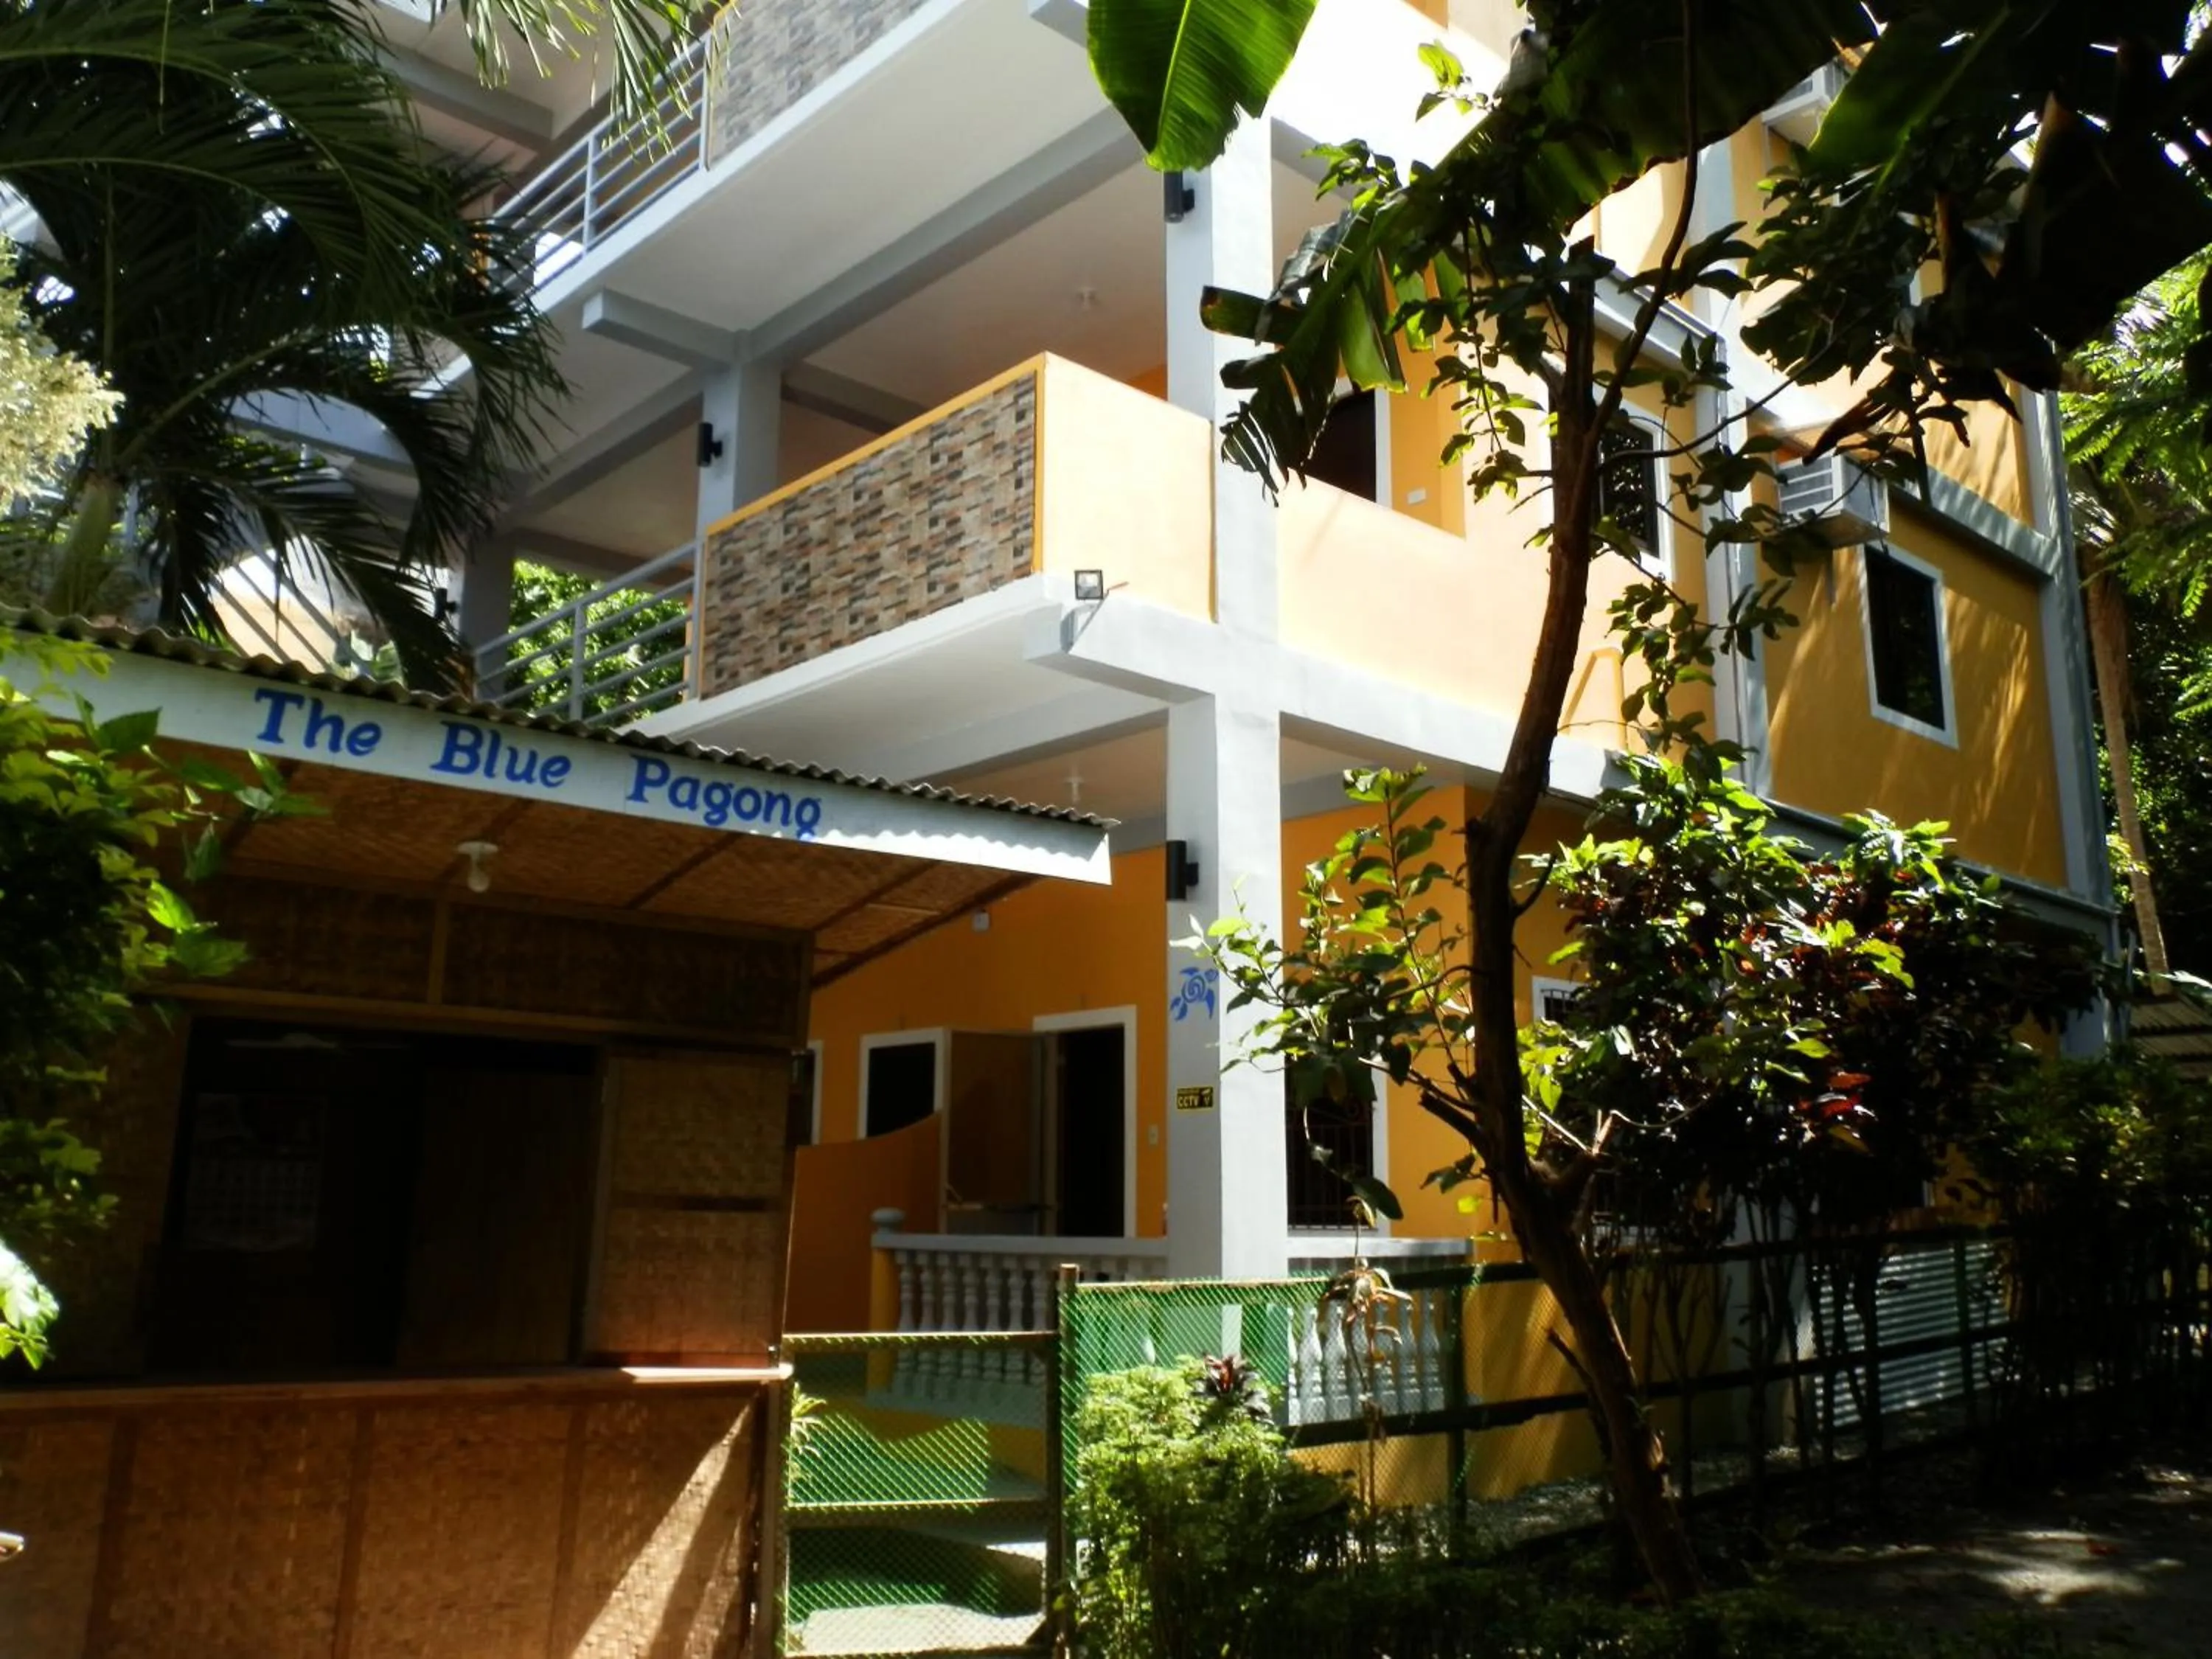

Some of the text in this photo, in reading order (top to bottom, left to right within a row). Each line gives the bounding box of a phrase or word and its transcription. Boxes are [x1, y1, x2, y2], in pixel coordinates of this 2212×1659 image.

[255, 689, 821, 841] The Blue Pagong
[1178, 1096, 1199, 1107] CCTV
